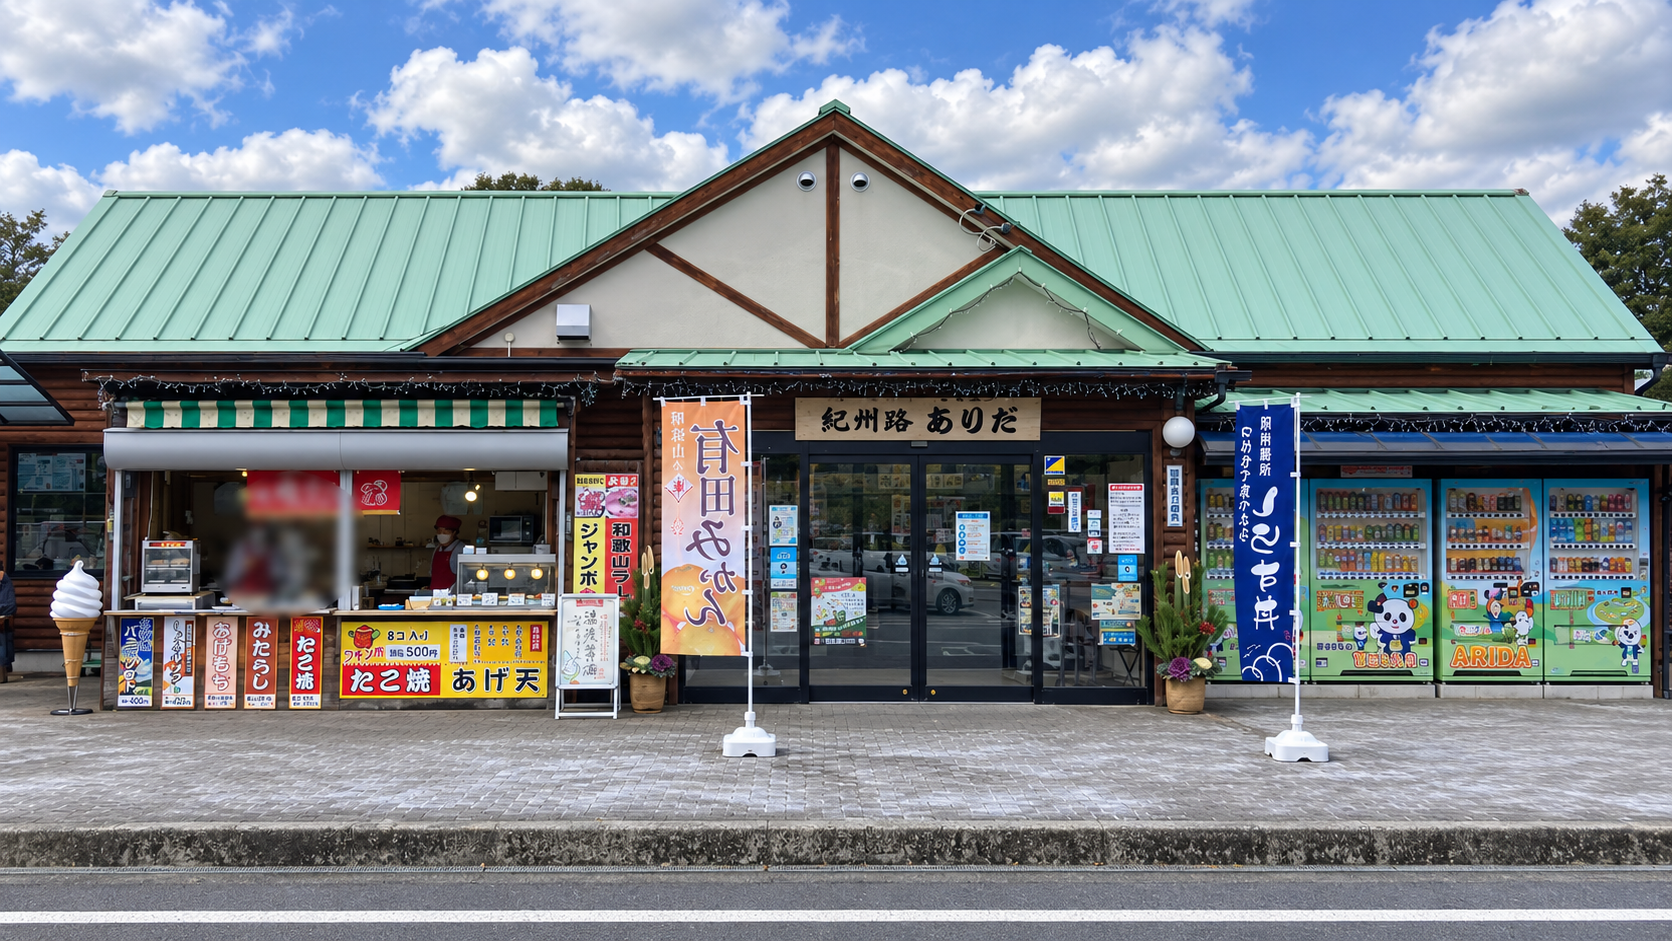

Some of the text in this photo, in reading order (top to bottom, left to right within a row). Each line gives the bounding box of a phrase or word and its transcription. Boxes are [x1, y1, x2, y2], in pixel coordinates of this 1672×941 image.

[821, 406, 1018, 435] 紀州路 ありだ
[252, 621, 272, 691] みたらし
[1449, 644, 1533, 669] ARIDA
[452, 666, 542, 692] あげ天
